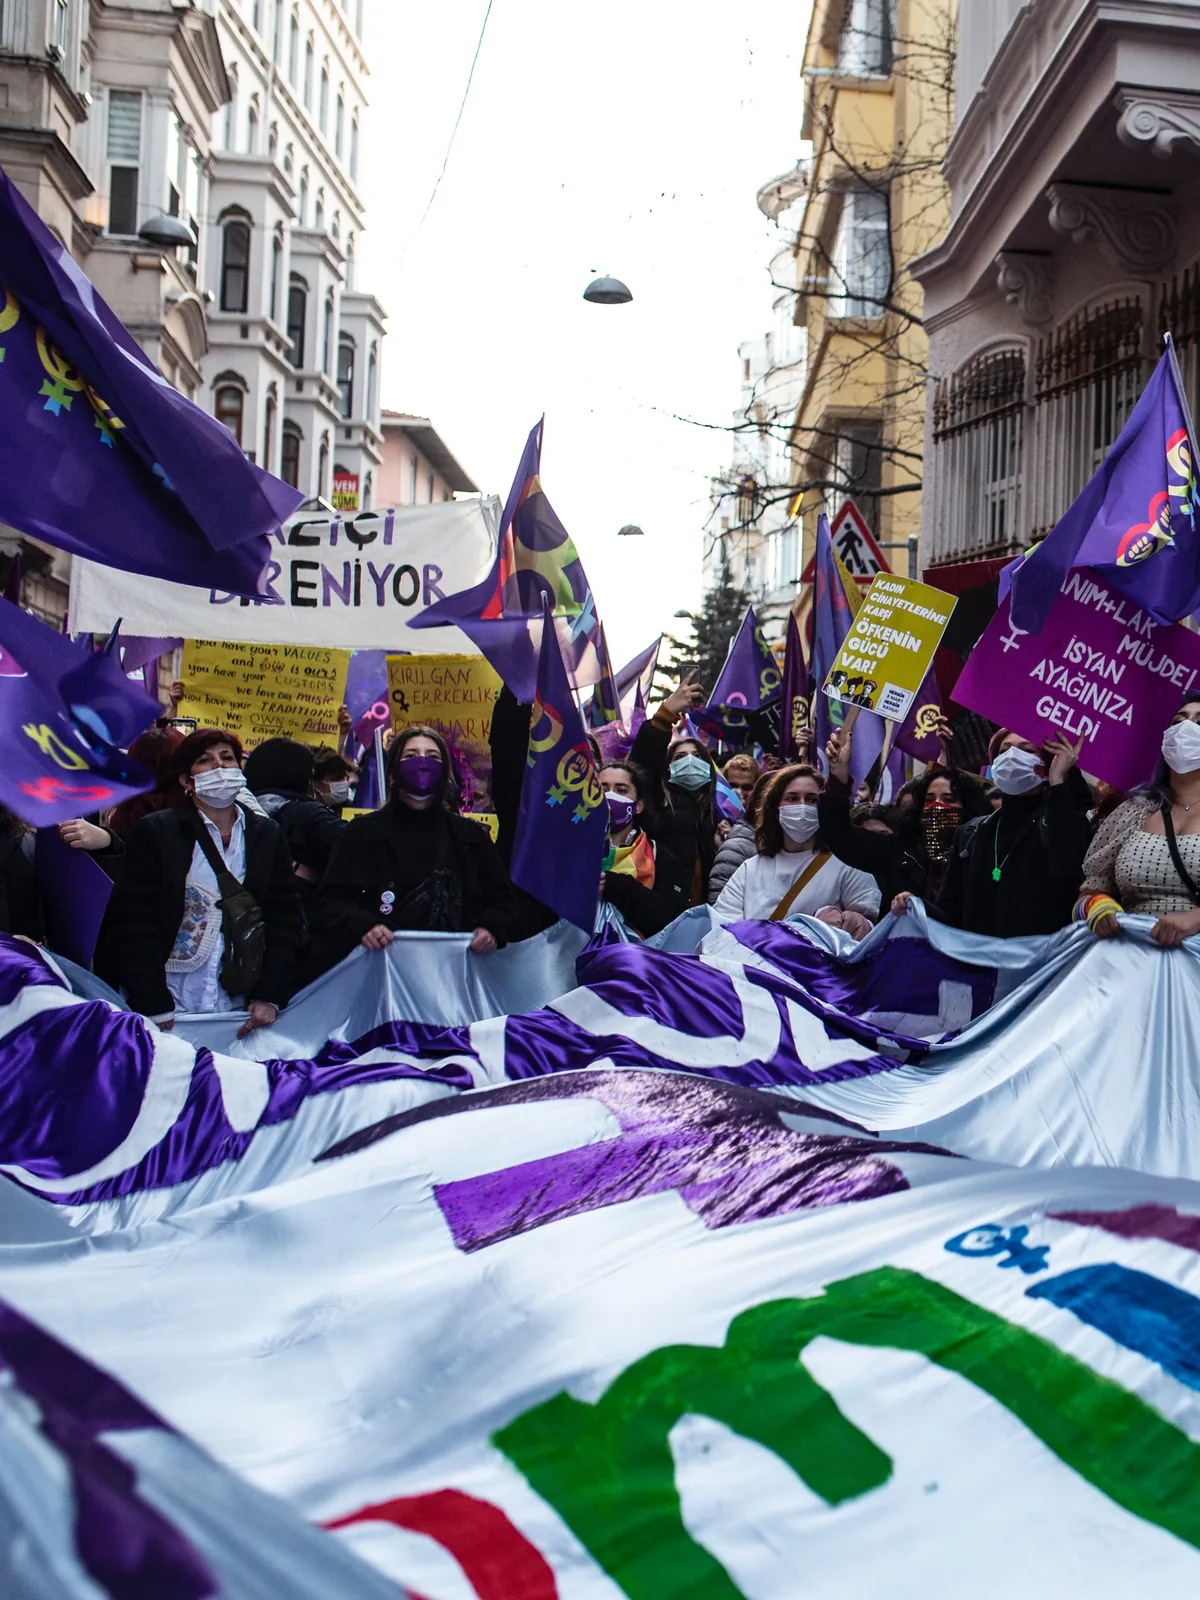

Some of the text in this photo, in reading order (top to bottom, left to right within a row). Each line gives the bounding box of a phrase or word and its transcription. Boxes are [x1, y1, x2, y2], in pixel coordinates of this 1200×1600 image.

[334, 480, 357, 492] VEN
[875, 579, 905, 594] KADIN
[863, 604, 893, 621] KARŞI
[870, 592, 948, 625] CİNAYETLERİNE
[856, 617, 922, 653] ÖFKENİN
[250, 646, 278, 656] your
[284, 646, 331, 664] VALUES
[848, 636, 889, 659] GÜCÜ
[231, 657, 255, 668] and
[841, 651, 877, 675] VAR!
[1062, 634, 1126, 685] İSYAN
[1116, 634, 1198, 694] MÜJDE!
[188, 664, 334, 692] you have your CUSTOMS
[1029, 658, 1134, 726] AYAĞINIZA
[250, 712, 285, 727] OWN
[261, 701, 334, 718] TRADITIONS
[1036, 695, 1101, 743] GELDİ
